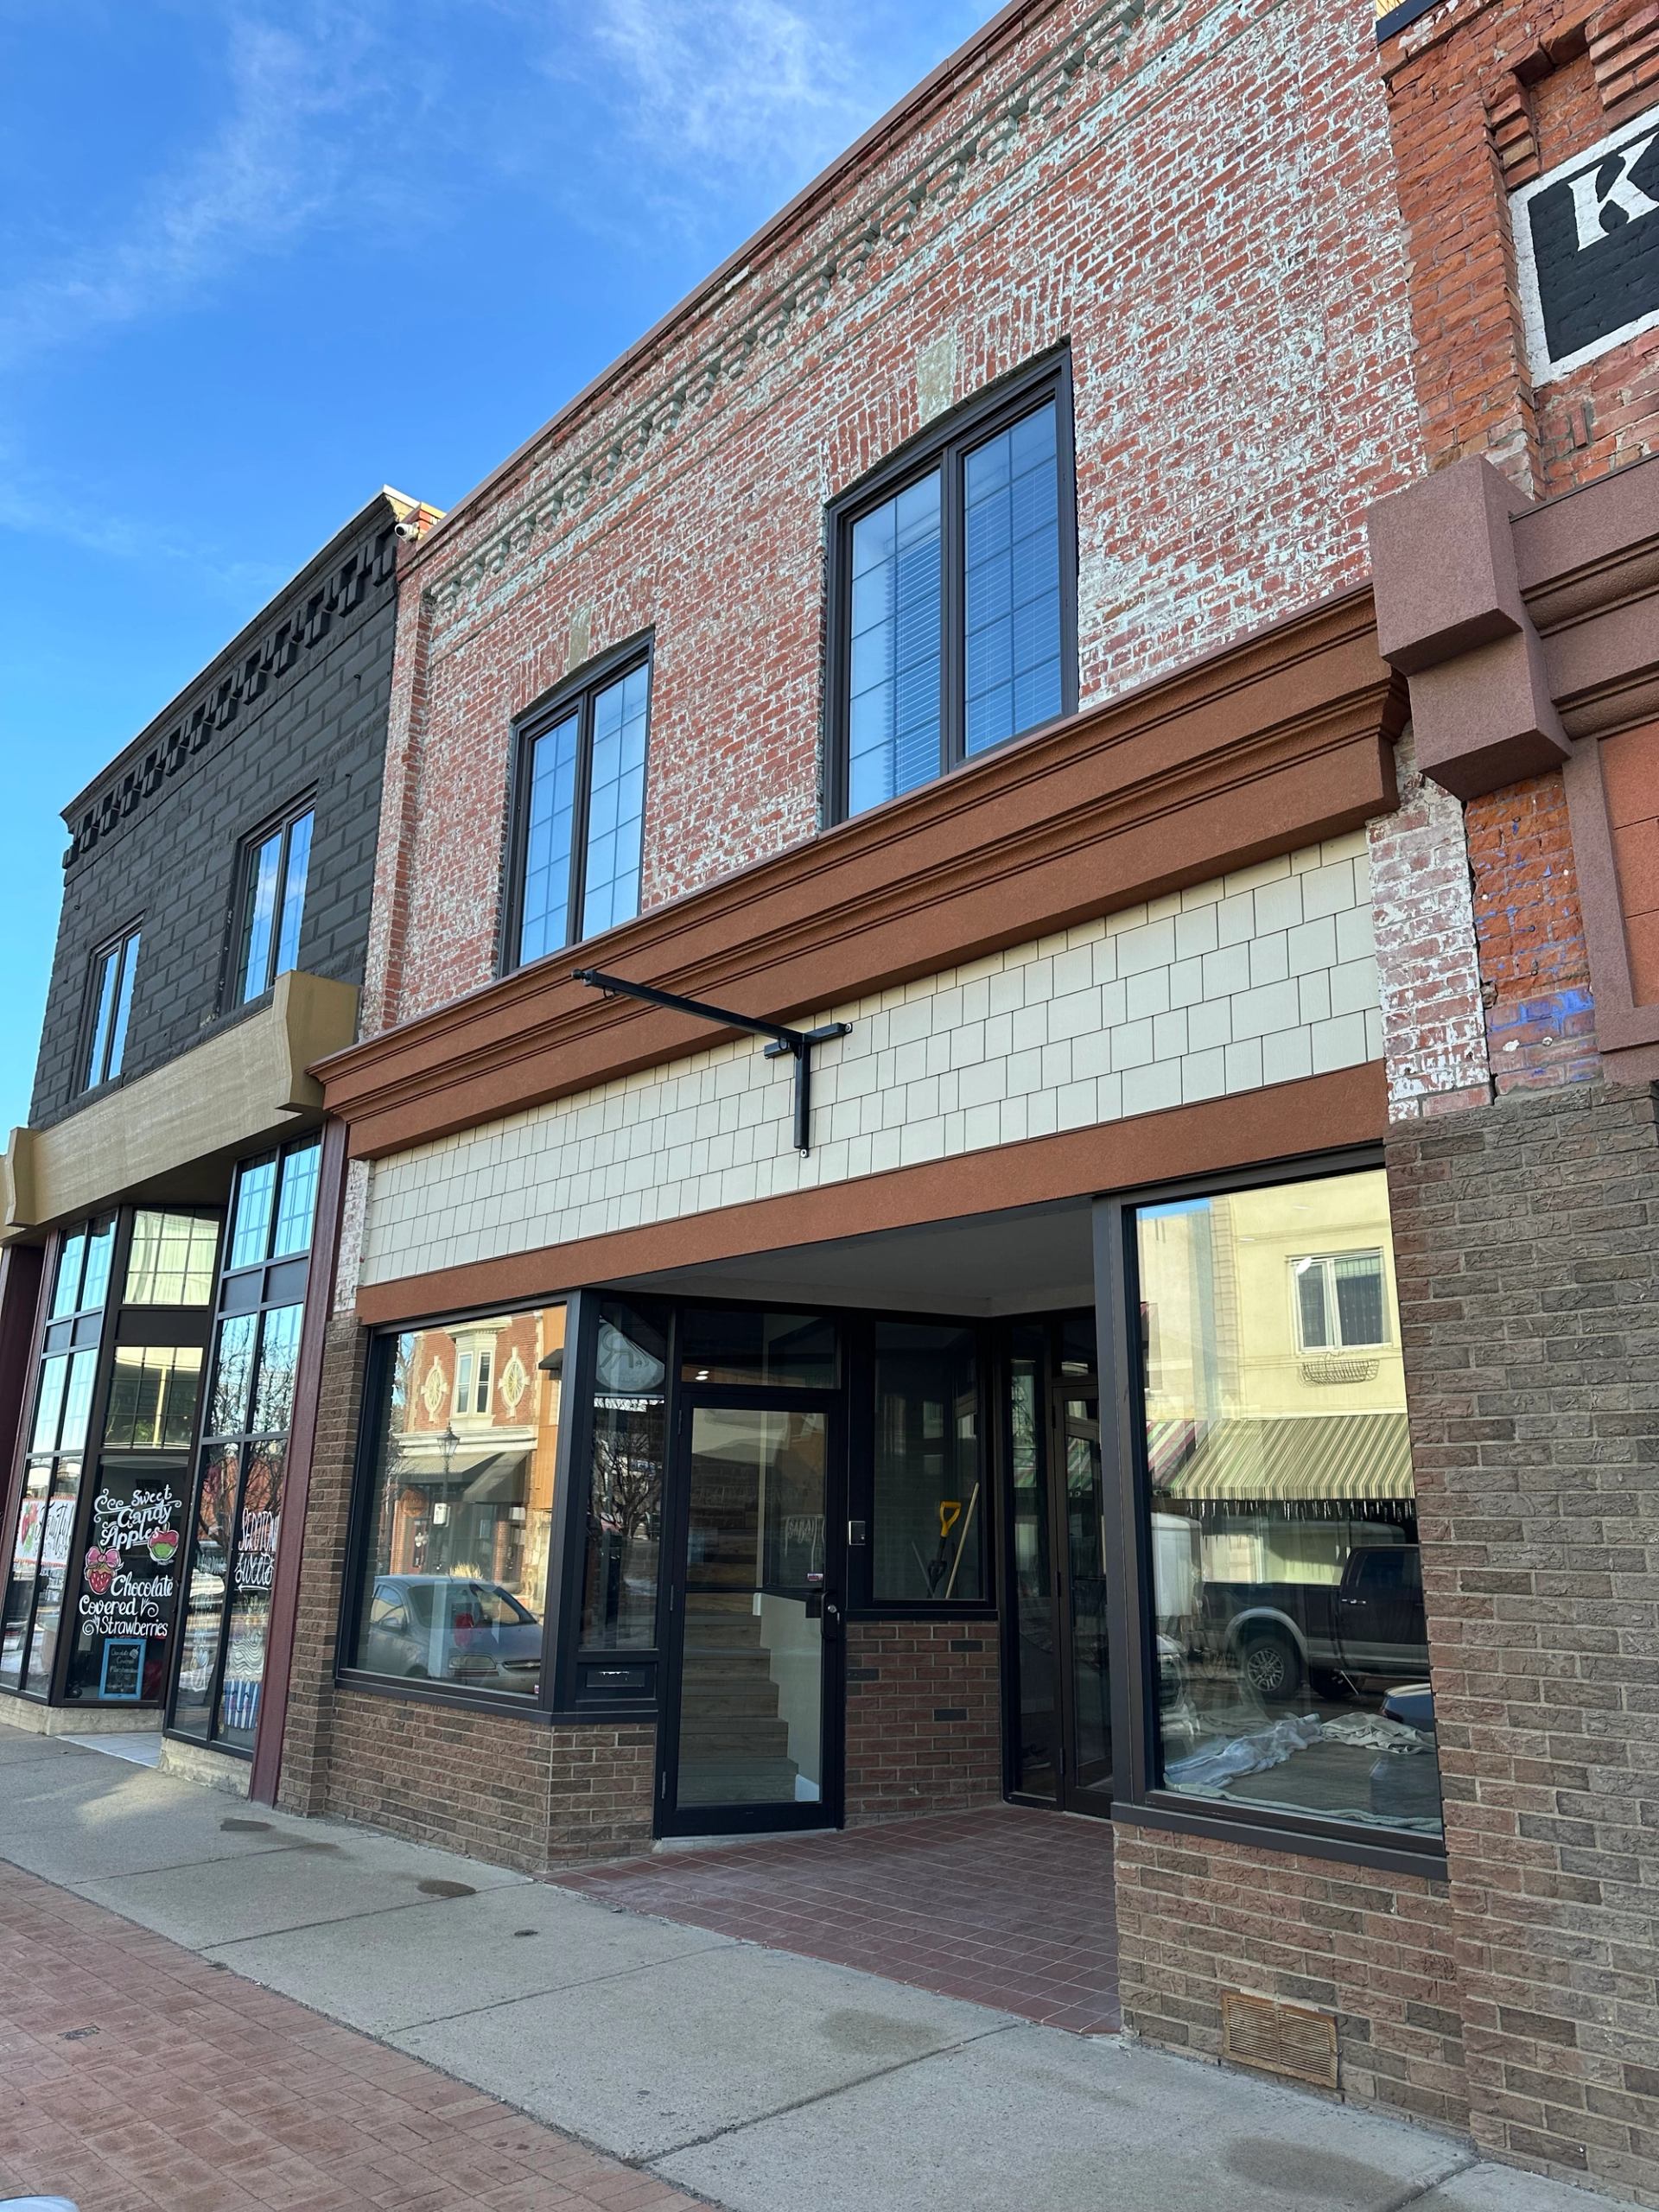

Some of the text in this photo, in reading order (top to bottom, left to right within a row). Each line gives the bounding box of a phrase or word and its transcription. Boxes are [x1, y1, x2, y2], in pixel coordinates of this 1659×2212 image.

[131, 1484, 172, 1506] Sweet
[118, 1499, 172, 1529] Candy
[100, 1522, 161, 1550] Apples
[111, 1571, 174, 1597] Chocolate
[79, 1595, 138, 1616] Covered
[99, 1616, 168, 1637] Strawberries
